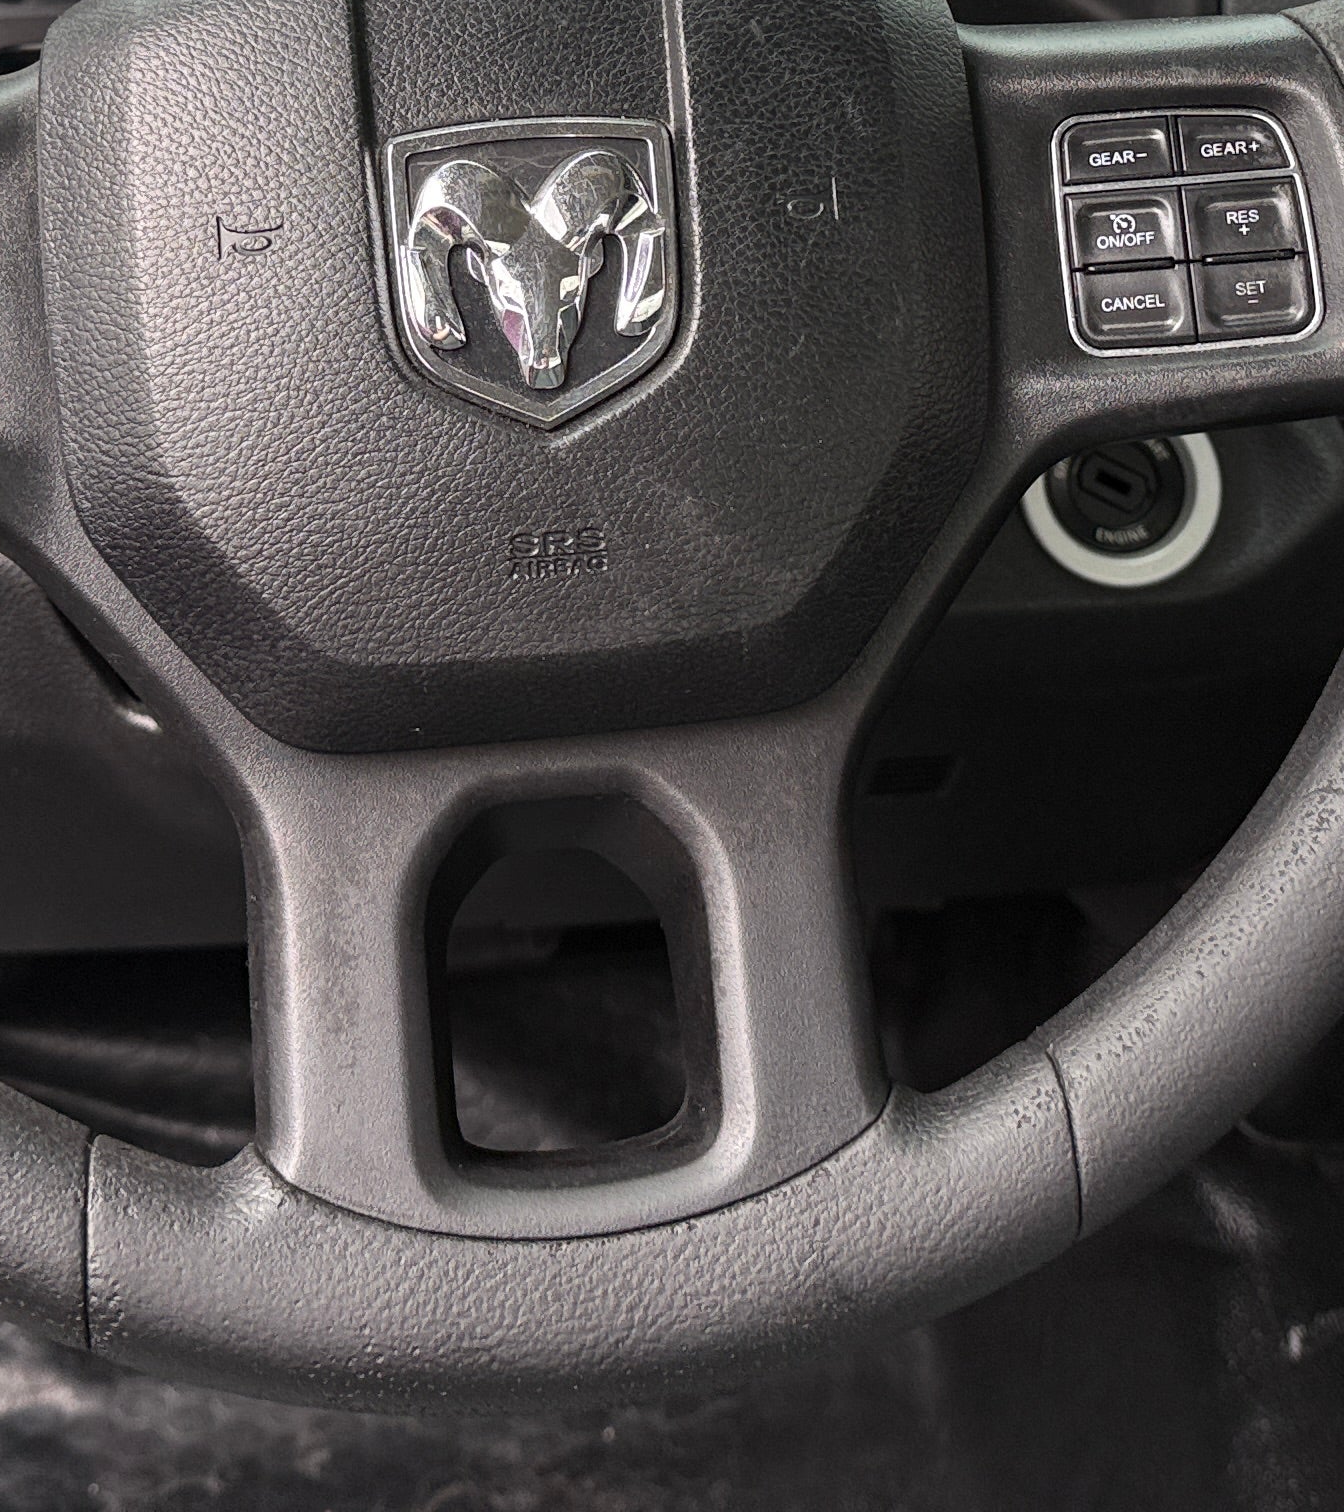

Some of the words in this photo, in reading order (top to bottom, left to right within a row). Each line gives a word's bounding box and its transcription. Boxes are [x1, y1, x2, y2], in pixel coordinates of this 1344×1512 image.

[1226, 209, 1259, 225] RES
[1096, 231, 1155, 250] ON/OFF
[1235, 280, 1266, 296] SET
[1101, 294, 1165, 312] CANCEL
[510, 527, 606, 558] SRS
[1095, 525, 1149, 545] ENGINE
[511, 555, 608, 581] AIRBAG
